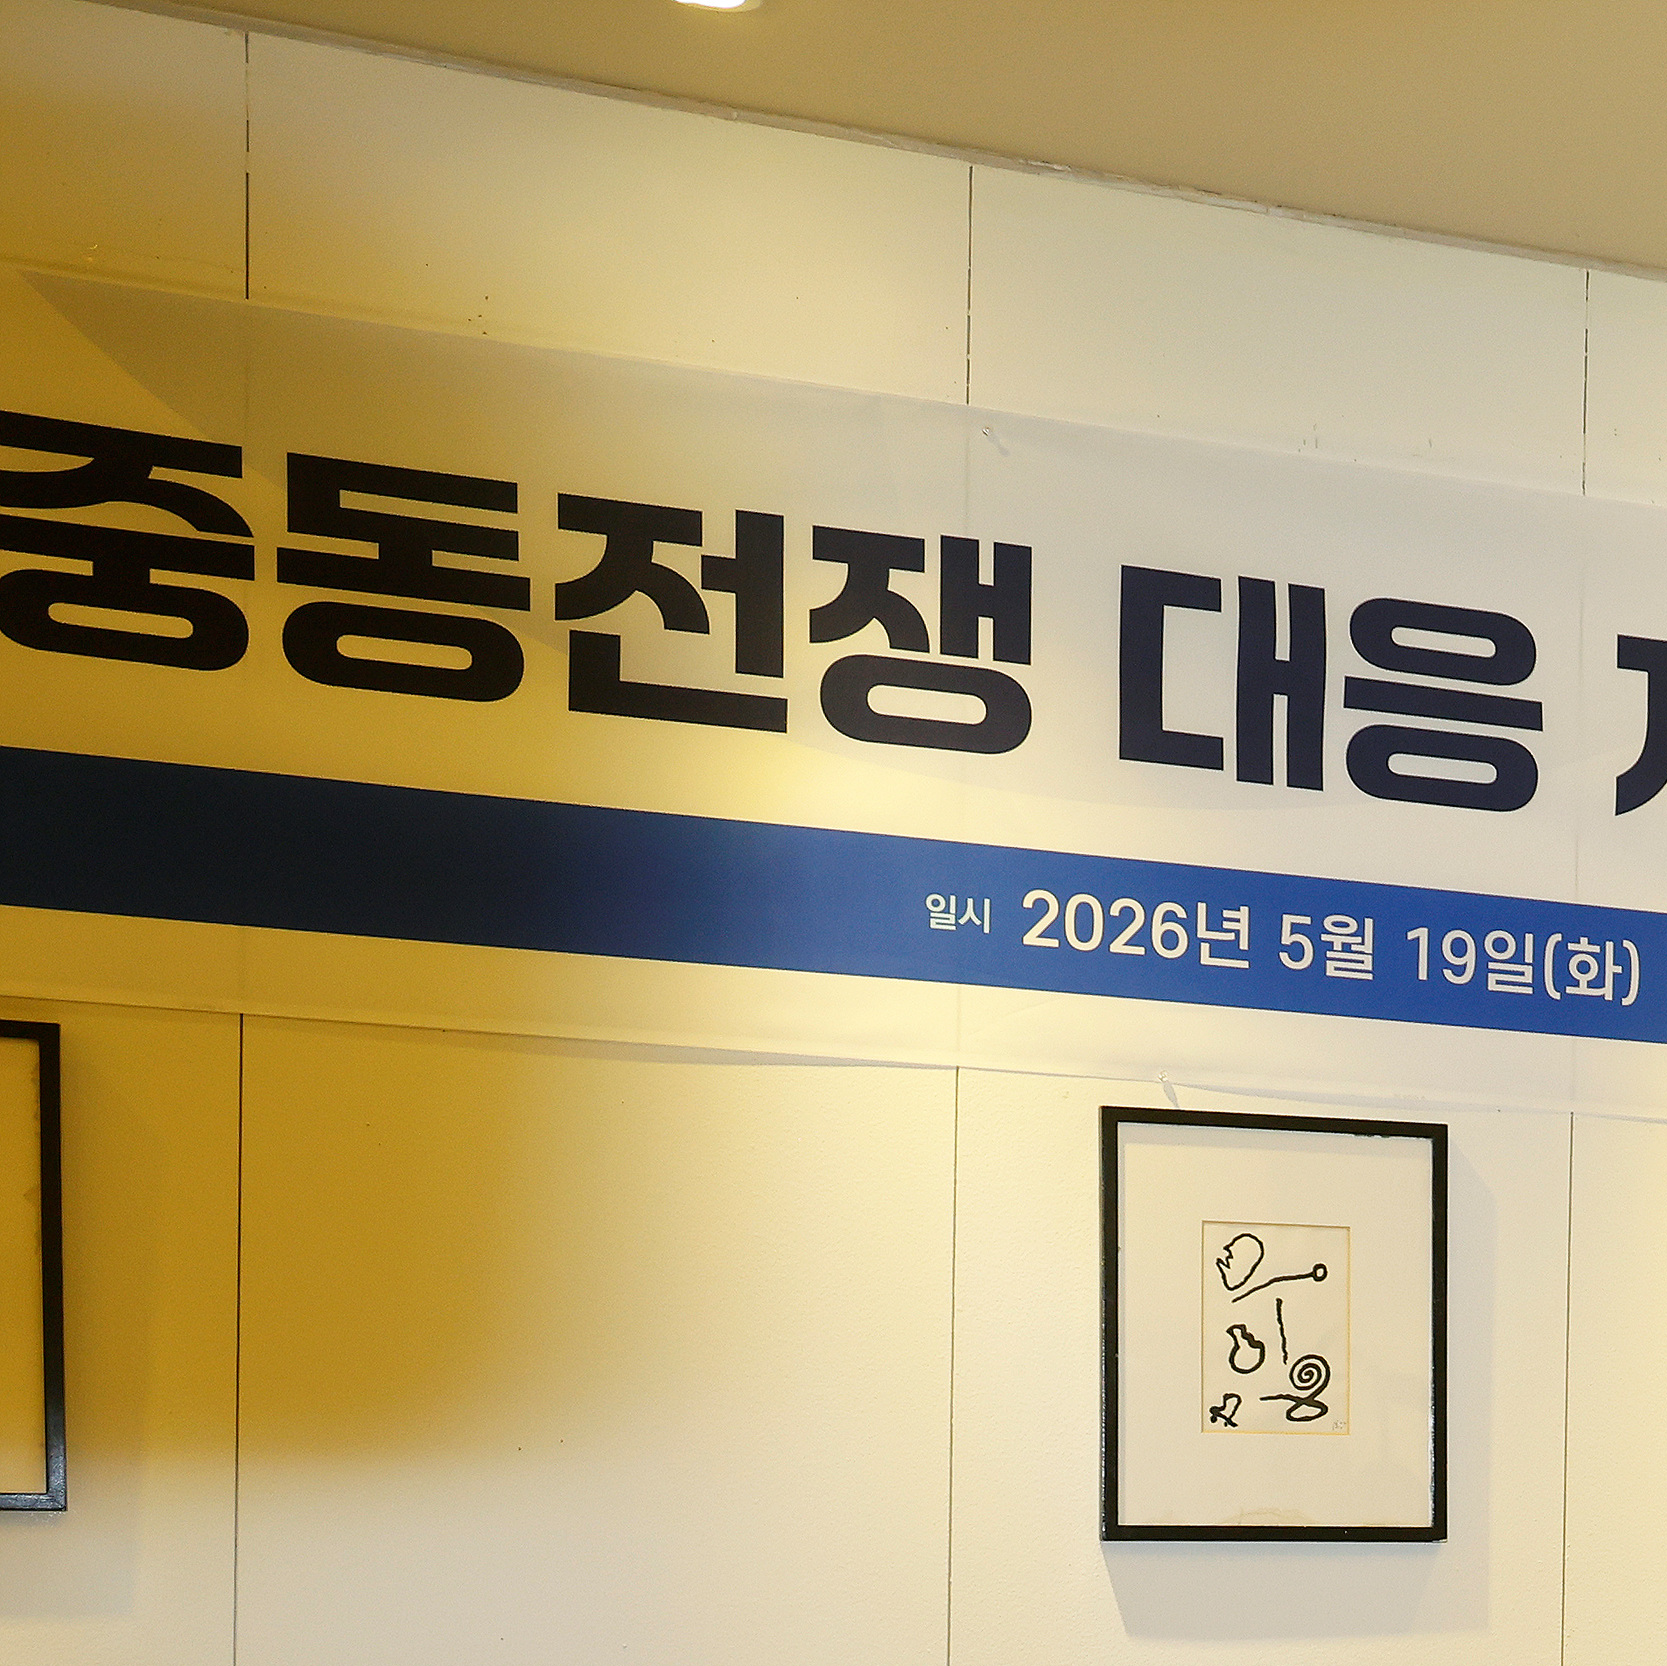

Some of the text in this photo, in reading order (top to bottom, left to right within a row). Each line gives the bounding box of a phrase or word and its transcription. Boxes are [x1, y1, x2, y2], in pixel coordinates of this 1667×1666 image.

[0, 410, 1032, 754] 중동전쟁
[1119, 565, 1544, 814] 대응
[925, 893, 992, 935] 일시
[1021, 888, 1253, 969] 2026년
[1280, 914, 1375, 980] 5월
[1407, 927, 1641, 1007] 19일(화)
